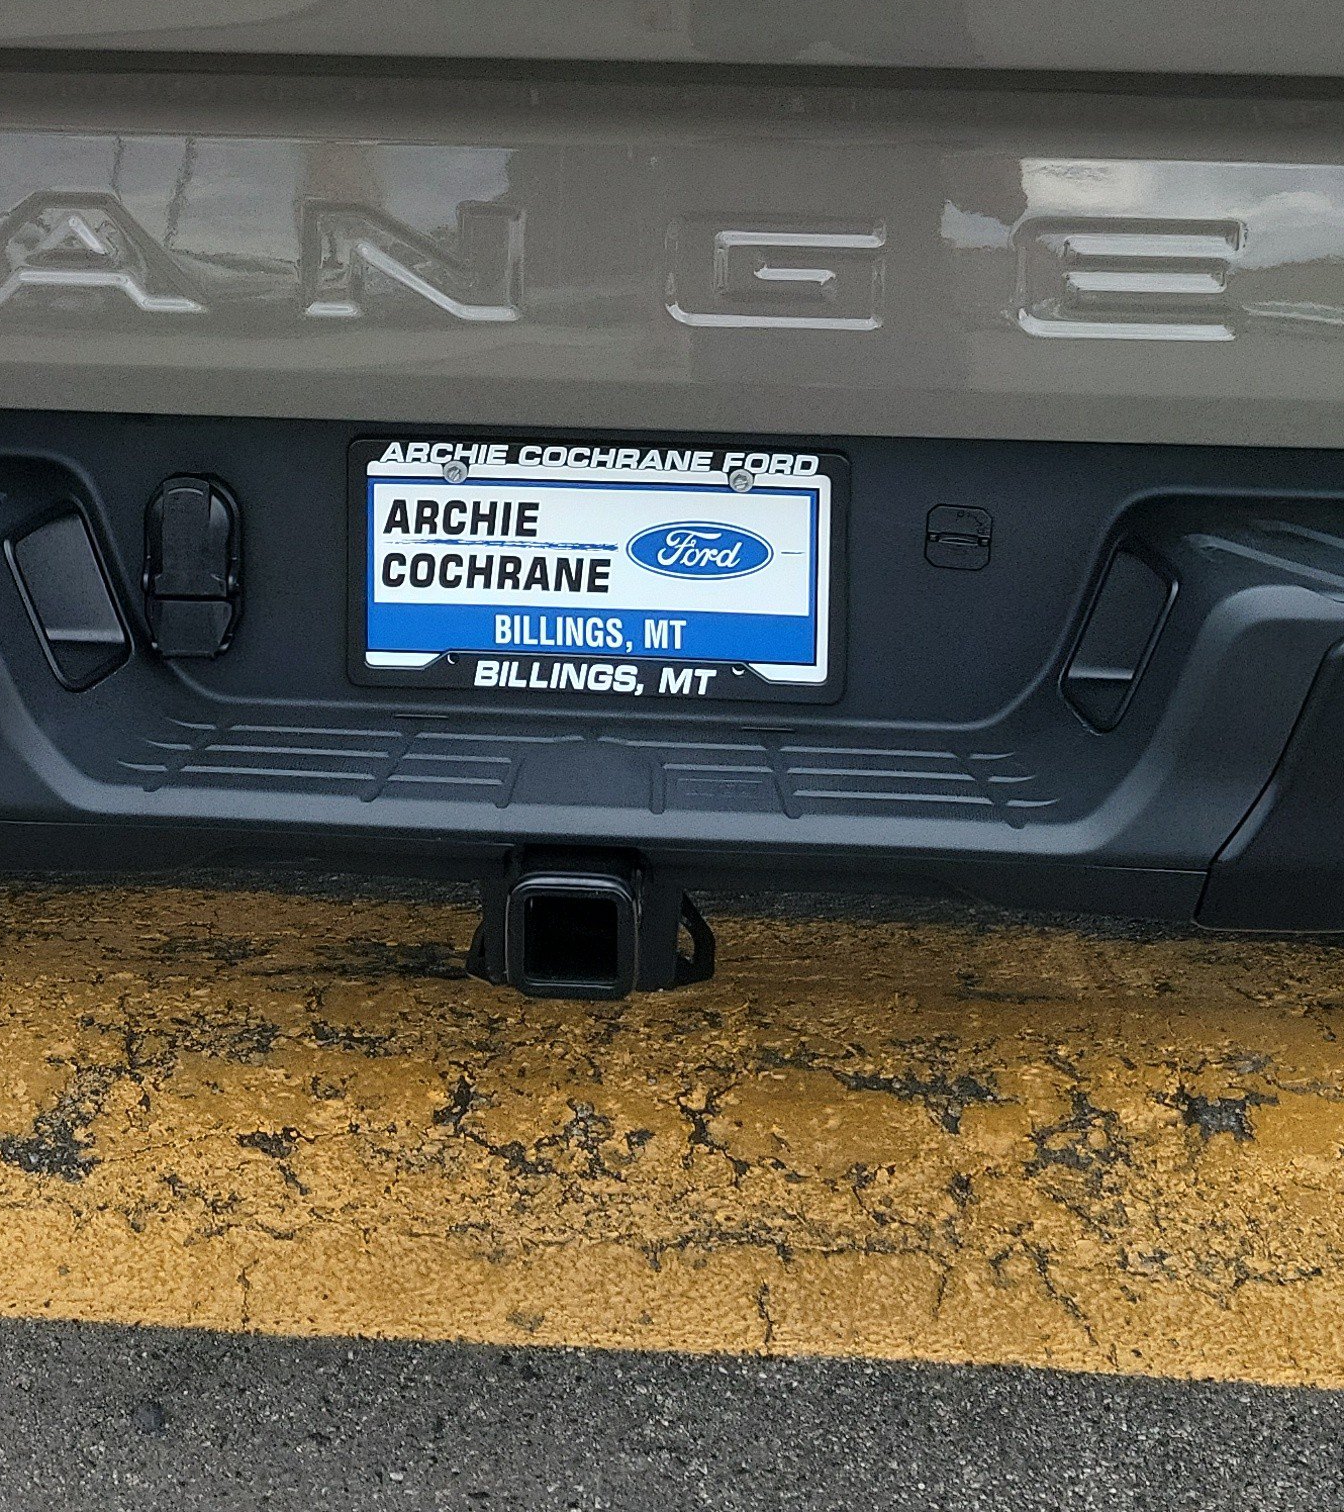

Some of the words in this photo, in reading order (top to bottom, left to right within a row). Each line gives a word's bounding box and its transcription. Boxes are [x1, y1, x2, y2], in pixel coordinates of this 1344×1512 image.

[379, 442, 509, 466] ARCHIE
[518, 445, 714, 472] COCHRANE
[722, 452, 819, 476] FORD
[383, 498, 541, 537] ARCHIE
[656, 530, 742, 569] Ford
[381, 552, 612, 593] COCHRANE
[495, 614, 634, 653] BILLINGS,
[644, 619, 687, 650] MT
[473, 660, 644, 696] BILLINGS,
[658, 666, 718, 696] MT
